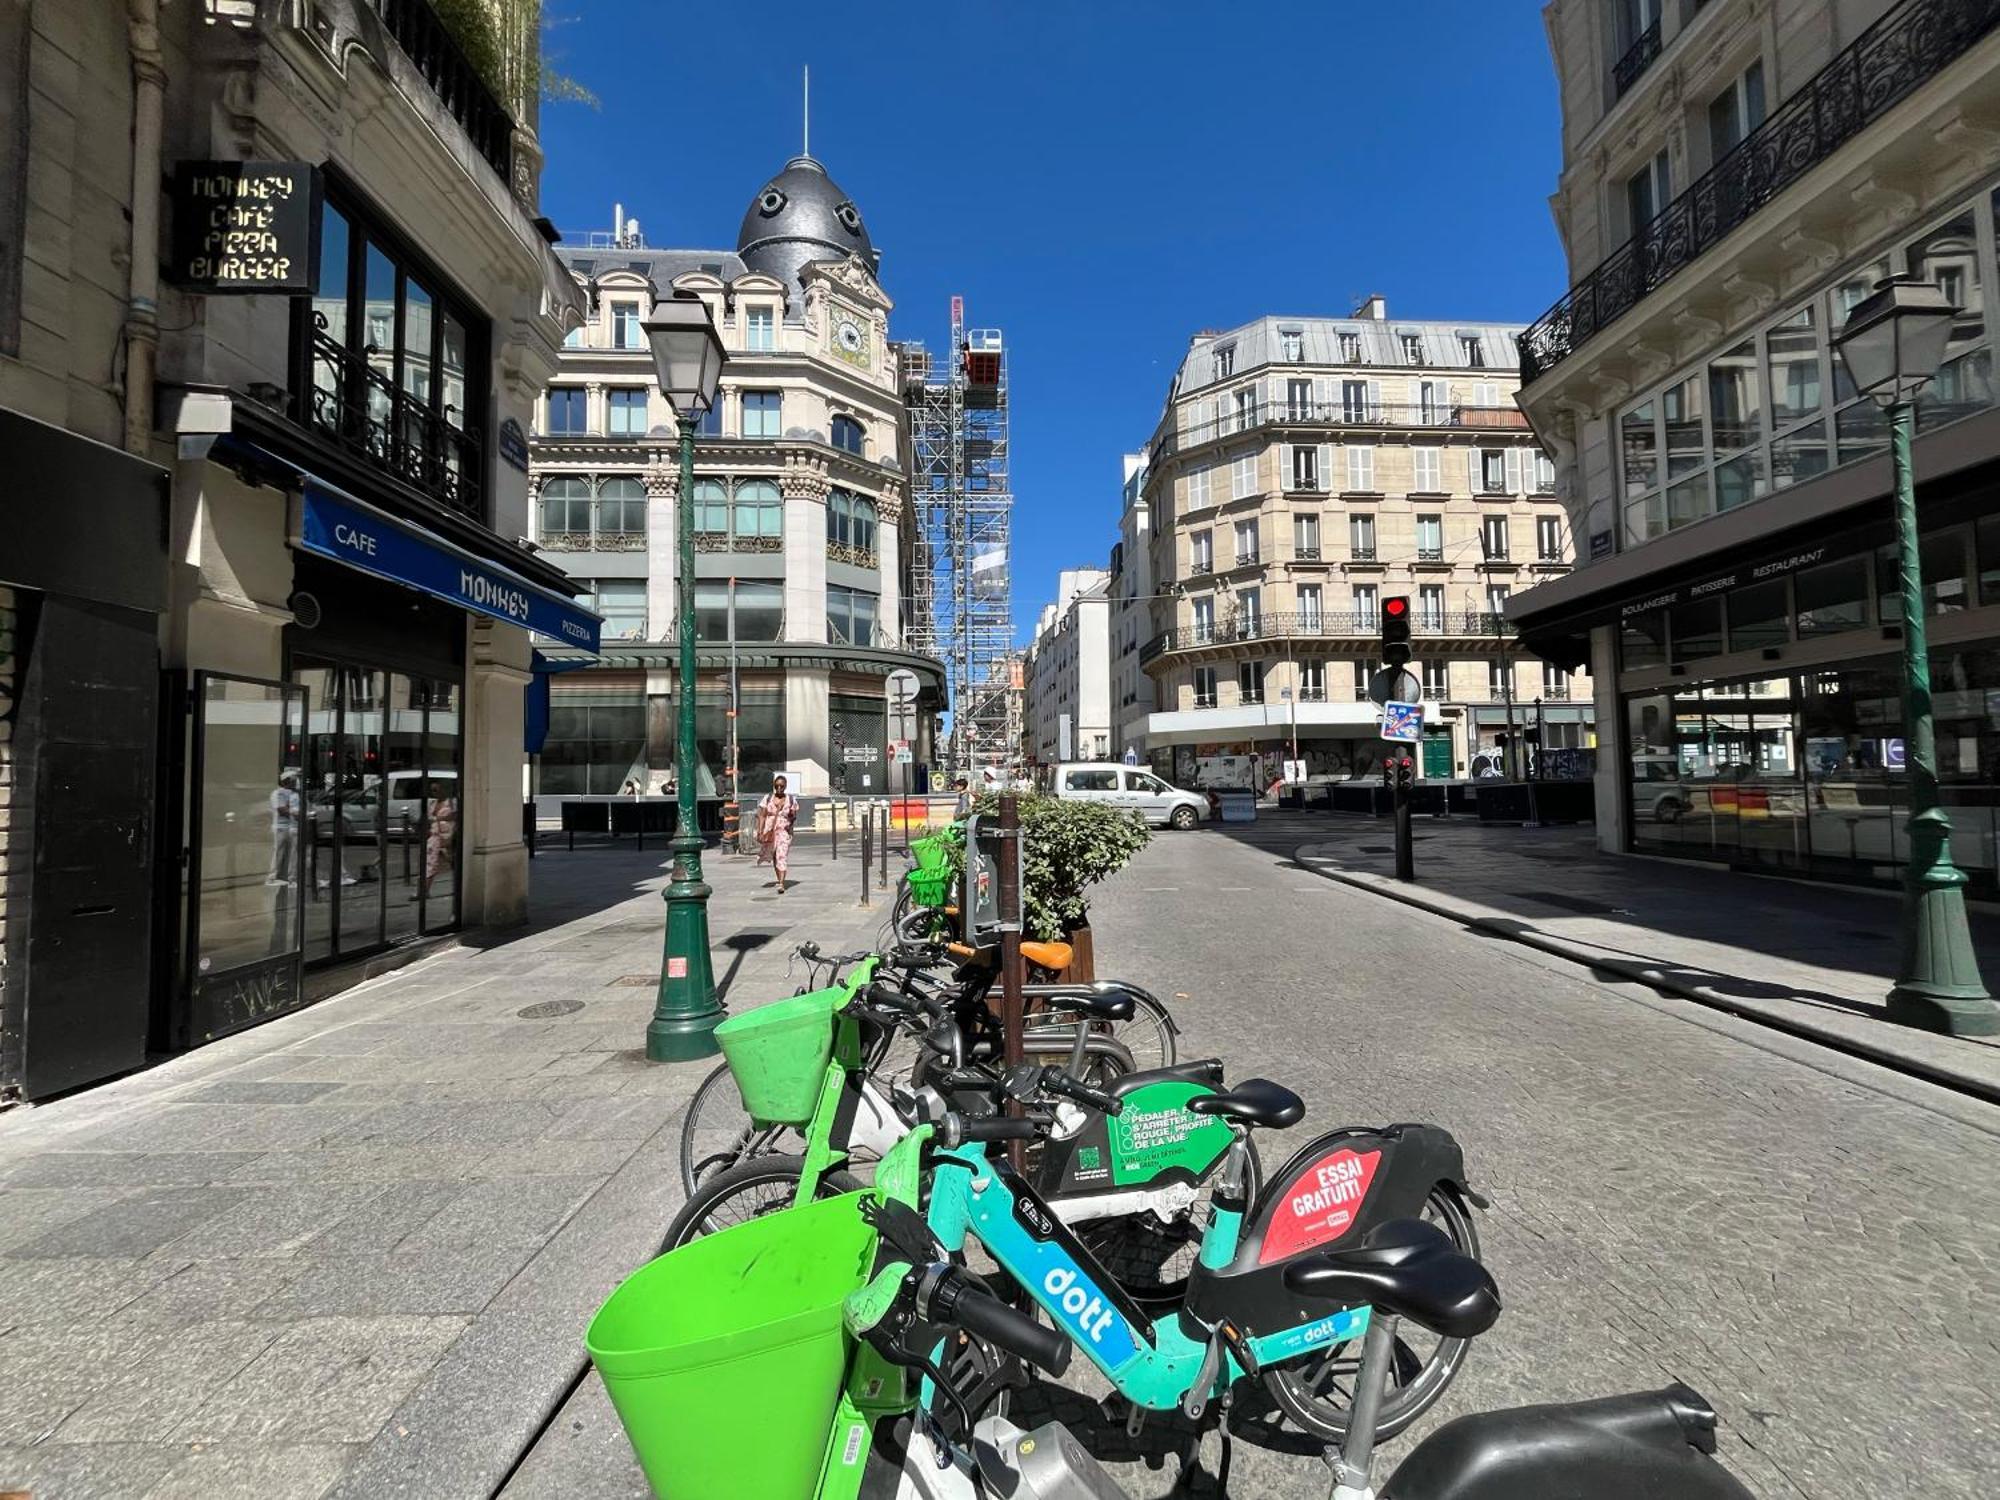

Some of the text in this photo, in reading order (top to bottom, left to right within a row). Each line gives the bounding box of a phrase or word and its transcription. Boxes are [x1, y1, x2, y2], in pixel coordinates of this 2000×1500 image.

[192, 176, 293, 199] MONKEY
[205, 232, 277, 254] PIZZA
[189, 257, 291, 280] BURGER
[335, 524, 591, 642] CAFE MONKEY PIZZERIA
[1621, 592, 1677, 616] BOULANGERIE
[1752, 549, 1825, 578] RESTAURANT
[1175, 1118, 1214, 1133] PROFITE
[1134, 1140, 1149, 1149] DE
[1152, 1137, 1165, 1146] LA
[1316, 1158, 1363, 1188] ESSAI
[1292, 1179, 1361, 1217] GRATUIT!
[1044, 1267, 1113, 1343] dott
[1303, 1320, 1336, 1342] dott
